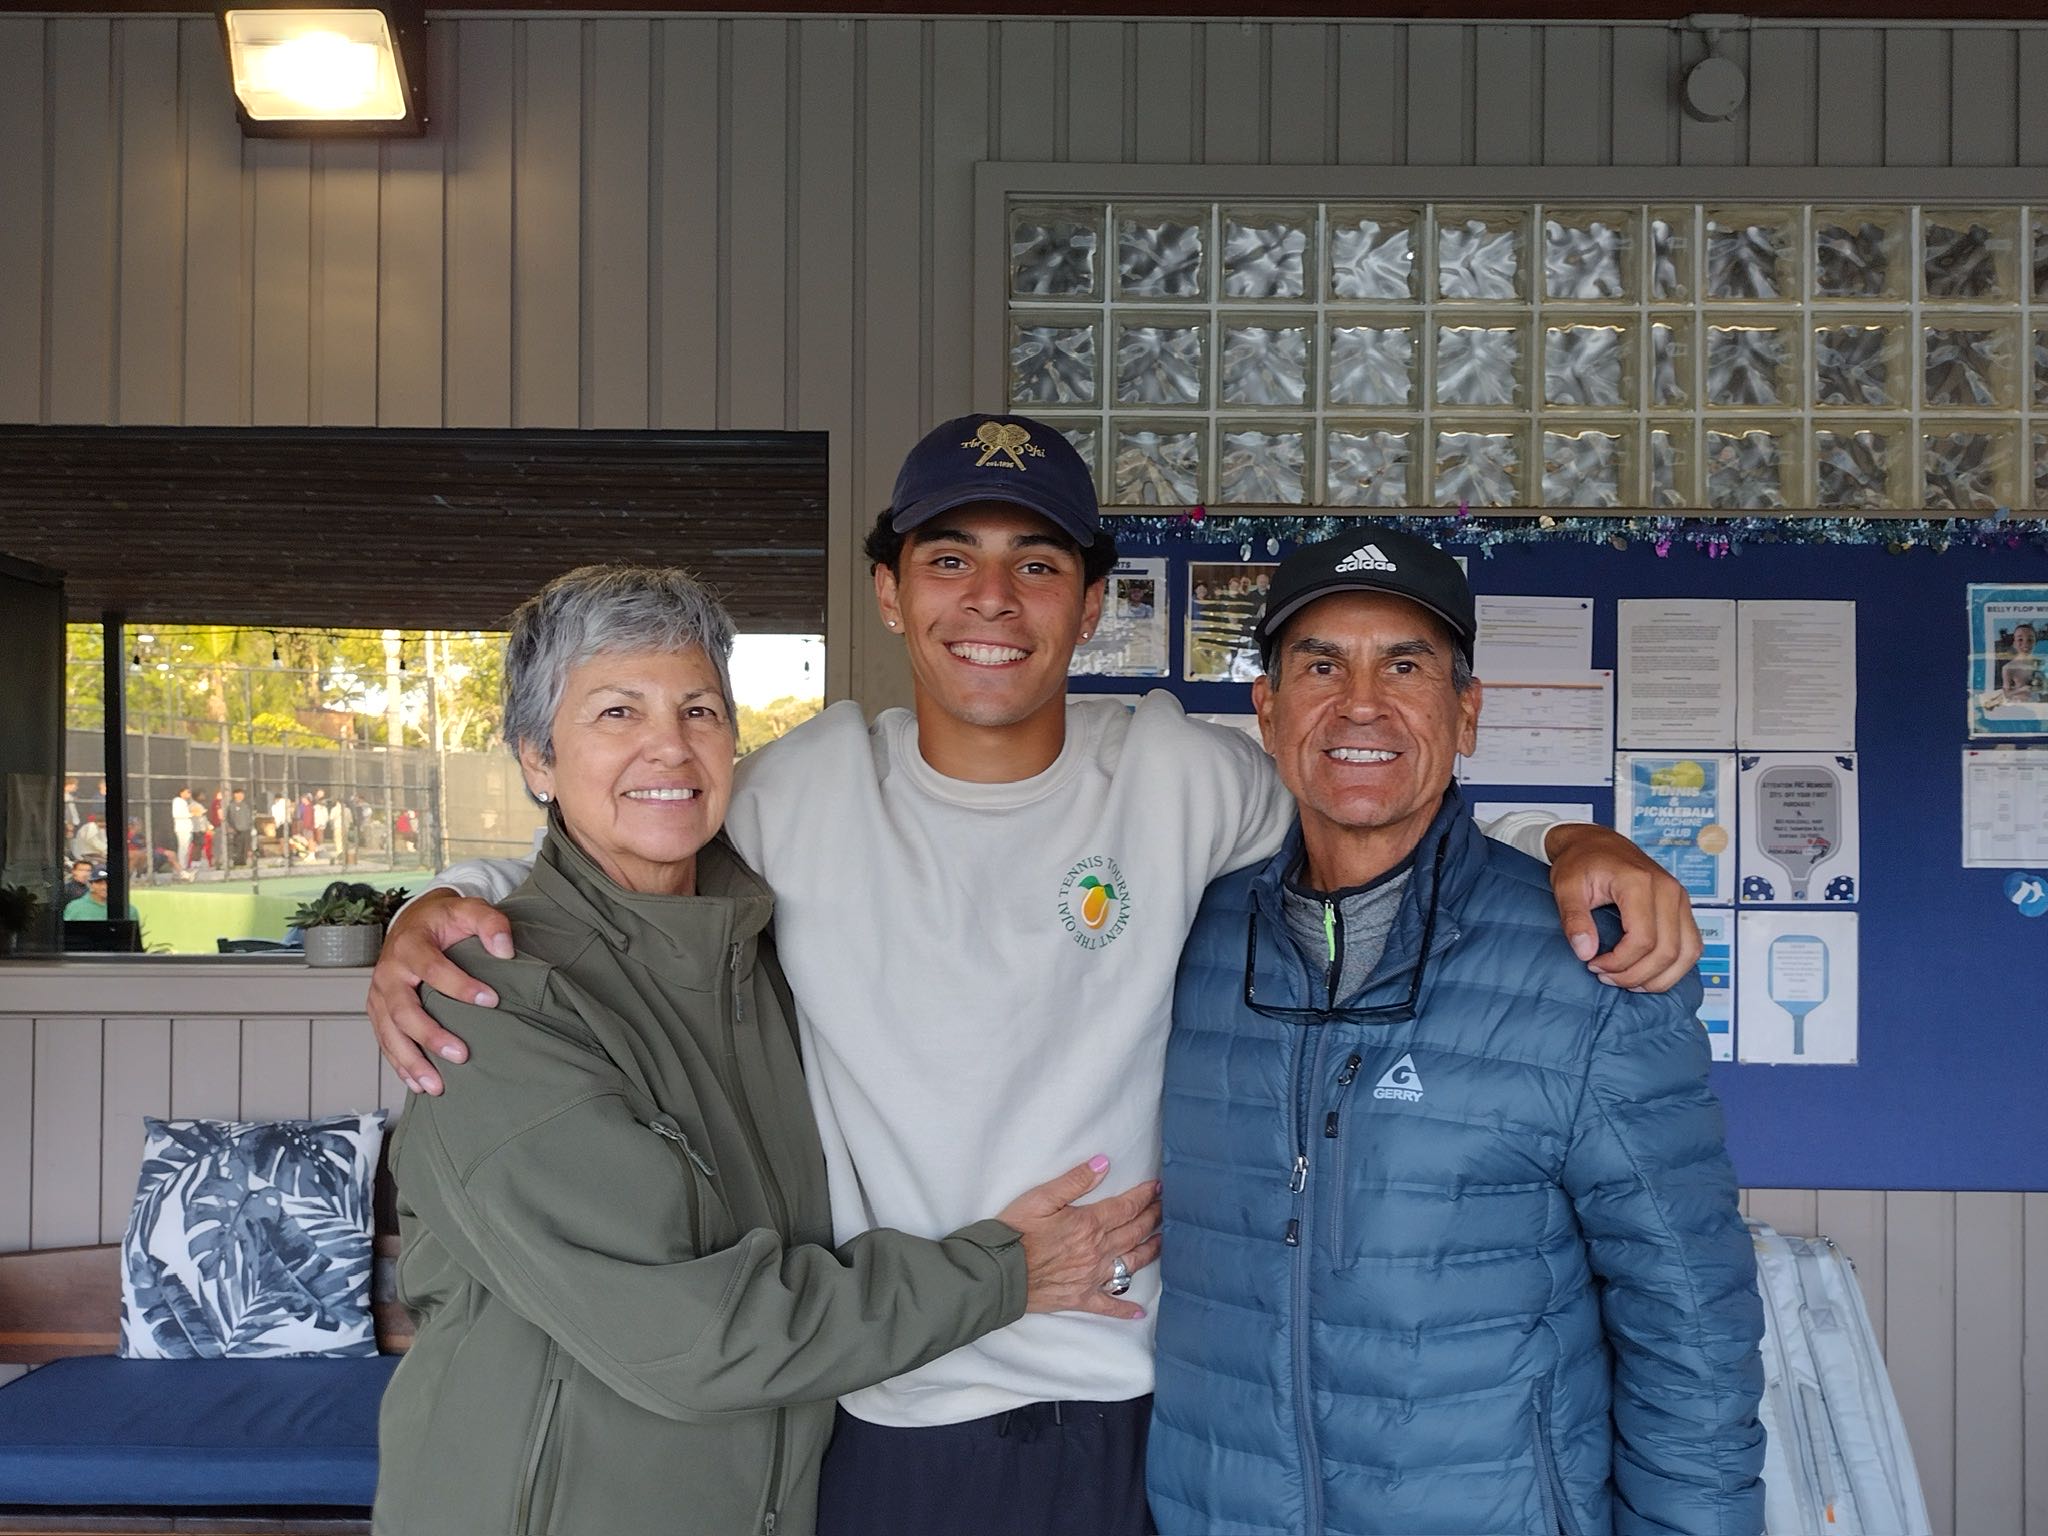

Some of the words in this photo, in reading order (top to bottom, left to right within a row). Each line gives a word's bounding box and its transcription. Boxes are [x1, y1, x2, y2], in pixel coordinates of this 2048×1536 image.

[1024, 443, 1046, 458] Ojai
[1335, 559, 1397, 573] adidas
[1987, 605, 2011, 613] BELLY
[2013, 605, 2034, 613] FLOP
[1650, 786, 1700, 797] TENNIS
[1669, 797, 1680, 806] &
[1634, 806, 1715, 818] PICKLEBALL
[1653, 817, 1703, 827] MACHINE
[1663, 827, 1692, 838] CLUB
[1059, 856, 1103, 897] TENNIS
[1100, 857, 1131, 948] TOURNAMENT
[1058, 902, 1076, 932] OJAI
[1073, 931, 1097, 950] THE
[1373, 1088, 1424, 1102] GERRY
